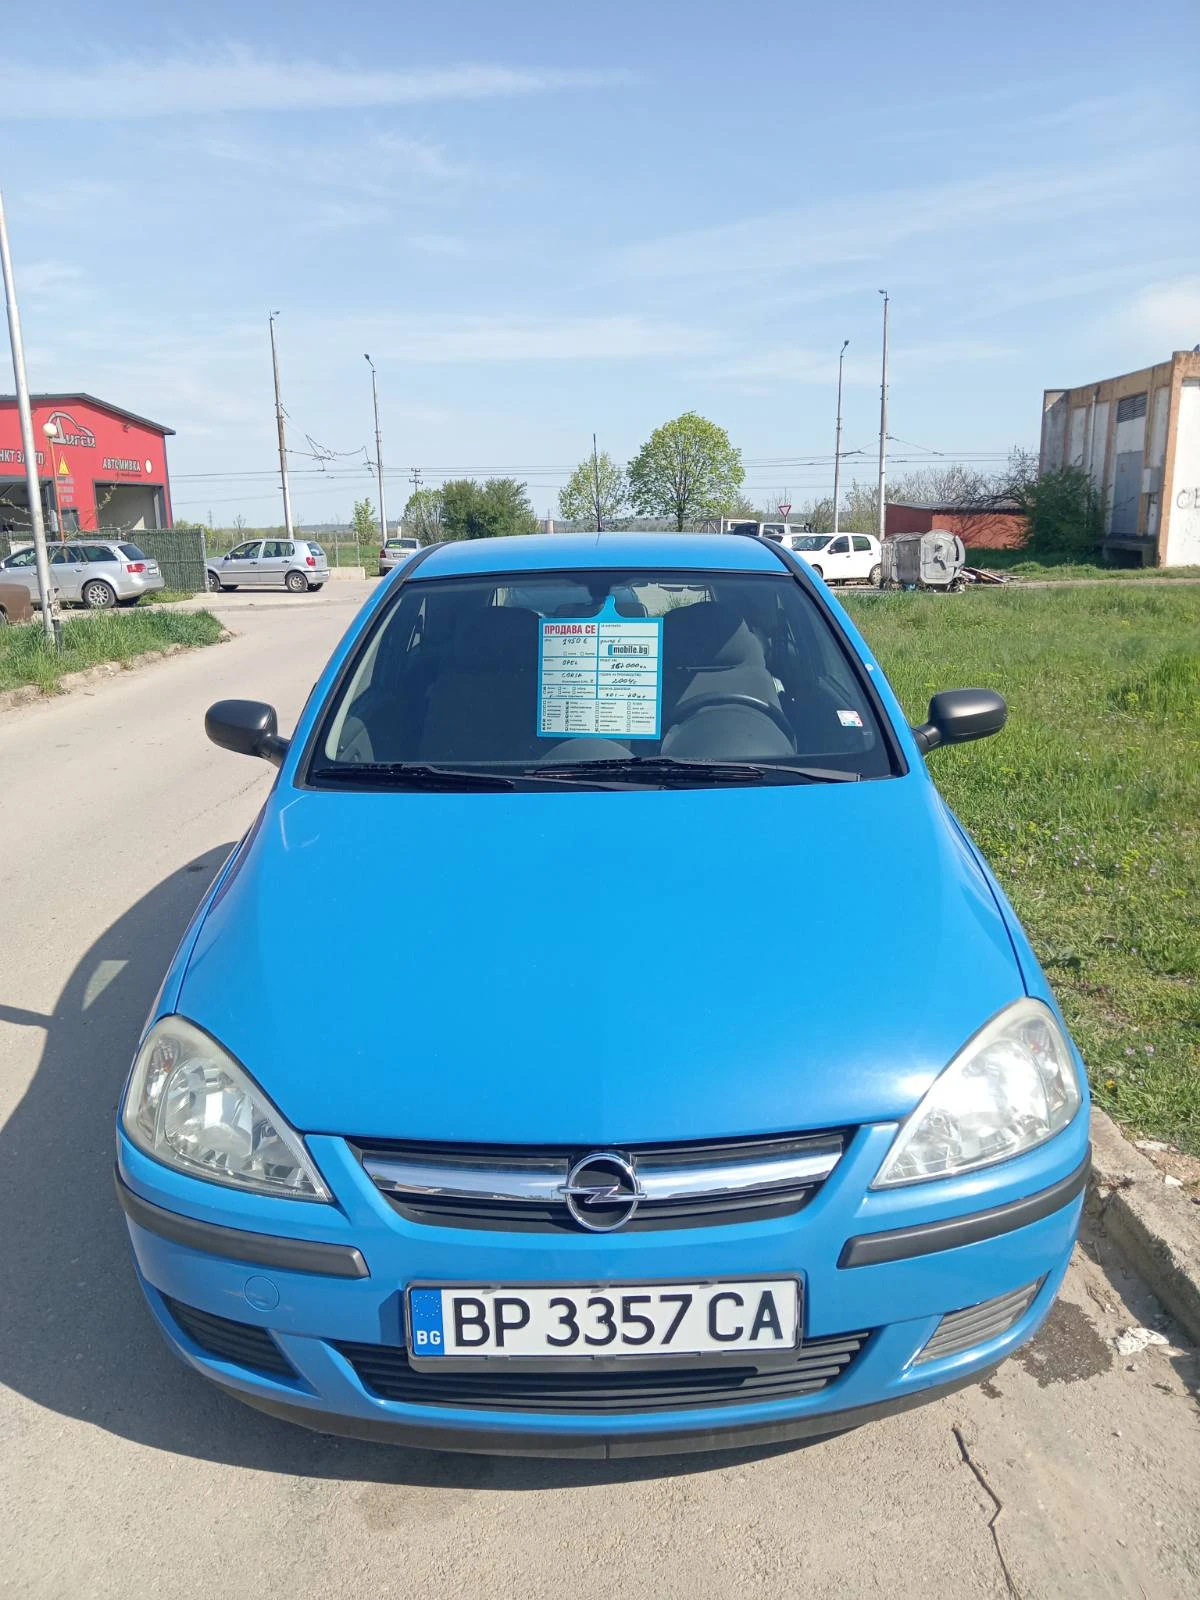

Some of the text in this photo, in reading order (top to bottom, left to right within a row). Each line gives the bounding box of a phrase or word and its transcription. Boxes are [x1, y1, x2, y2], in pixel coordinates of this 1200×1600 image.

[103, 458, 141, 471] АВТОМИВКА
[544, 625, 596, 635] ПРОДАВА СЕ
[613, 645, 648, 655] mobile.bg
[453, 1290, 784, 1348] BP 3357 CA
[416, 1330, 441, 1345] BG
